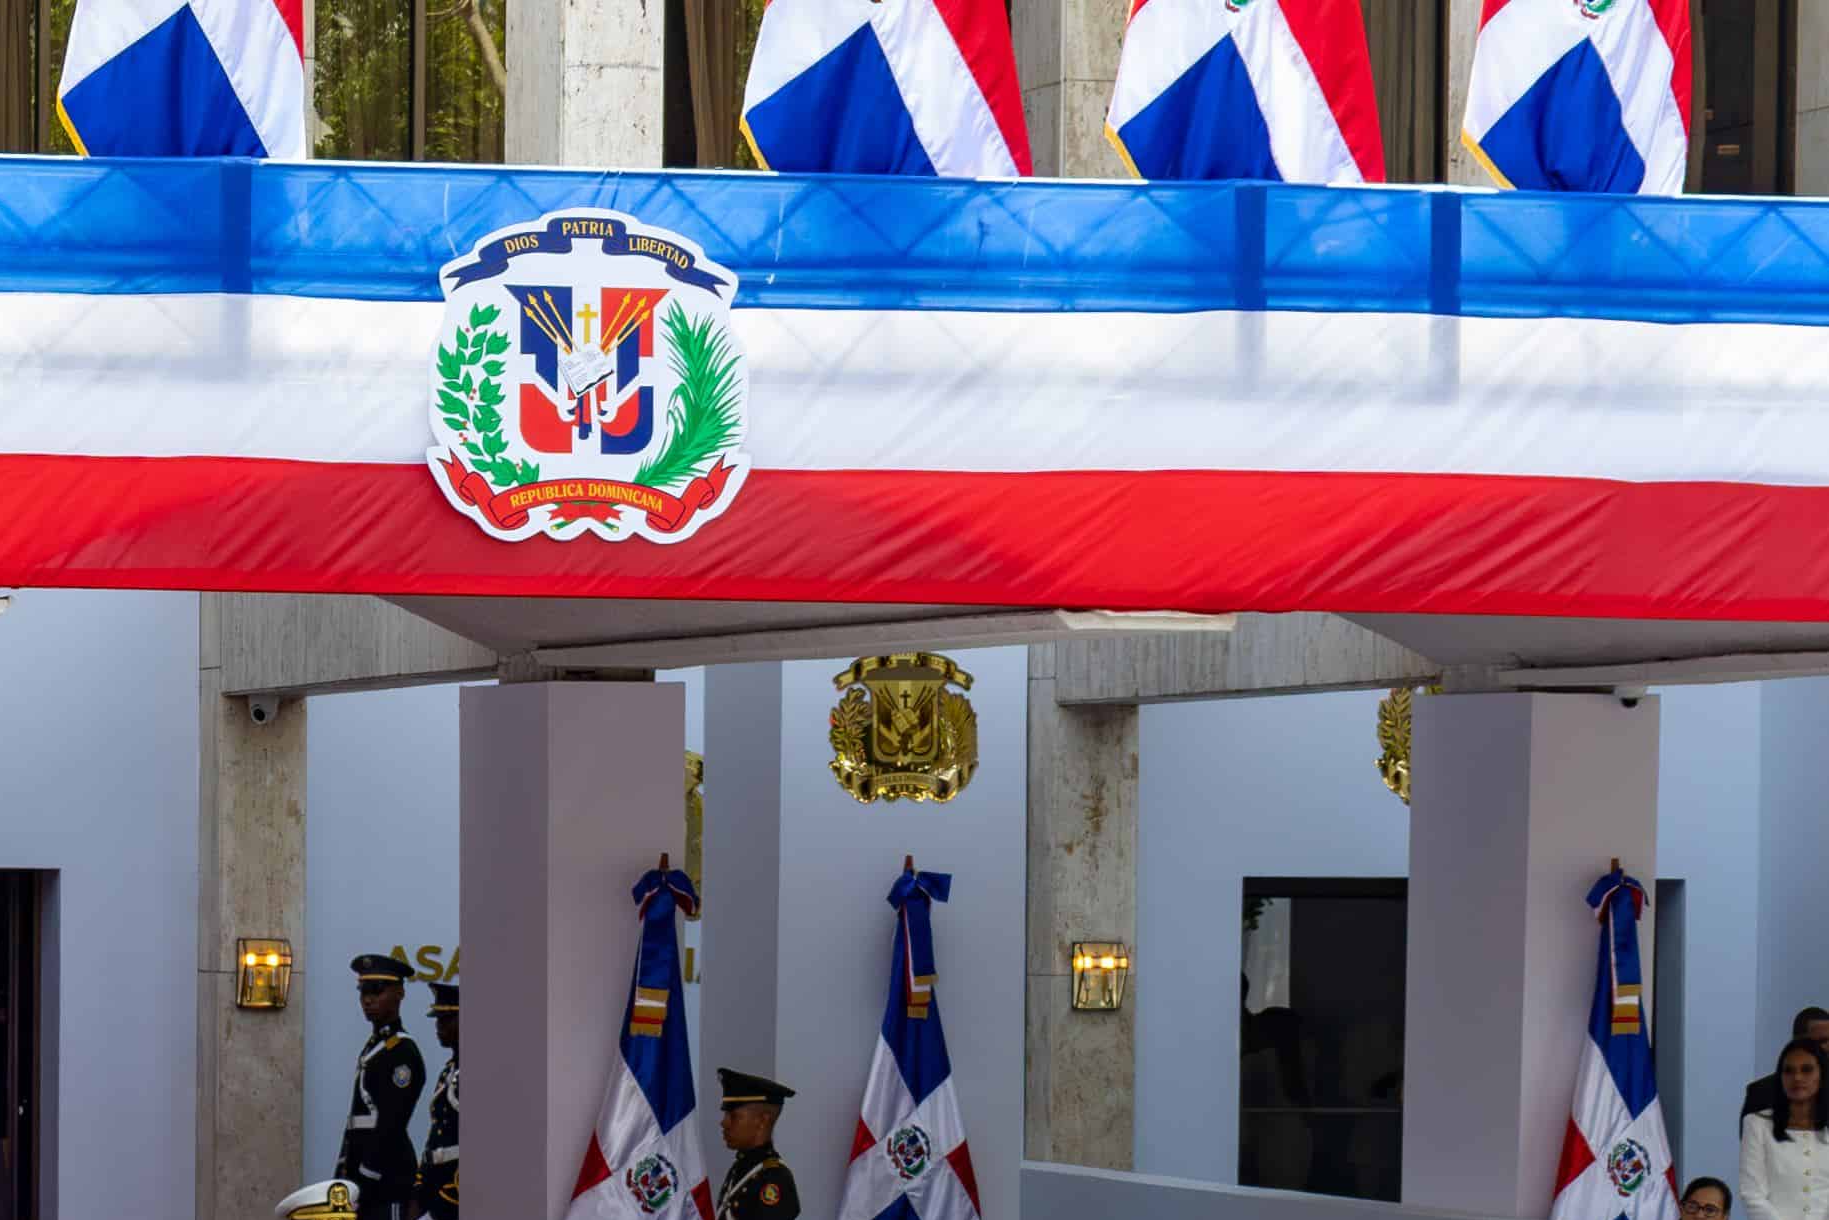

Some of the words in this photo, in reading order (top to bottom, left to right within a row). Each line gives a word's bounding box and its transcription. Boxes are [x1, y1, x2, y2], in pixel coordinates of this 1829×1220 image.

[504, 235, 539, 254] DIOS
[562, 221, 614, 237] PATRIA
[629, 237, 689, 270] LIBERTAD
[510, 482, 583, 507] REPUBLICA
[587, 483, 663, 511] DOMINICANA
